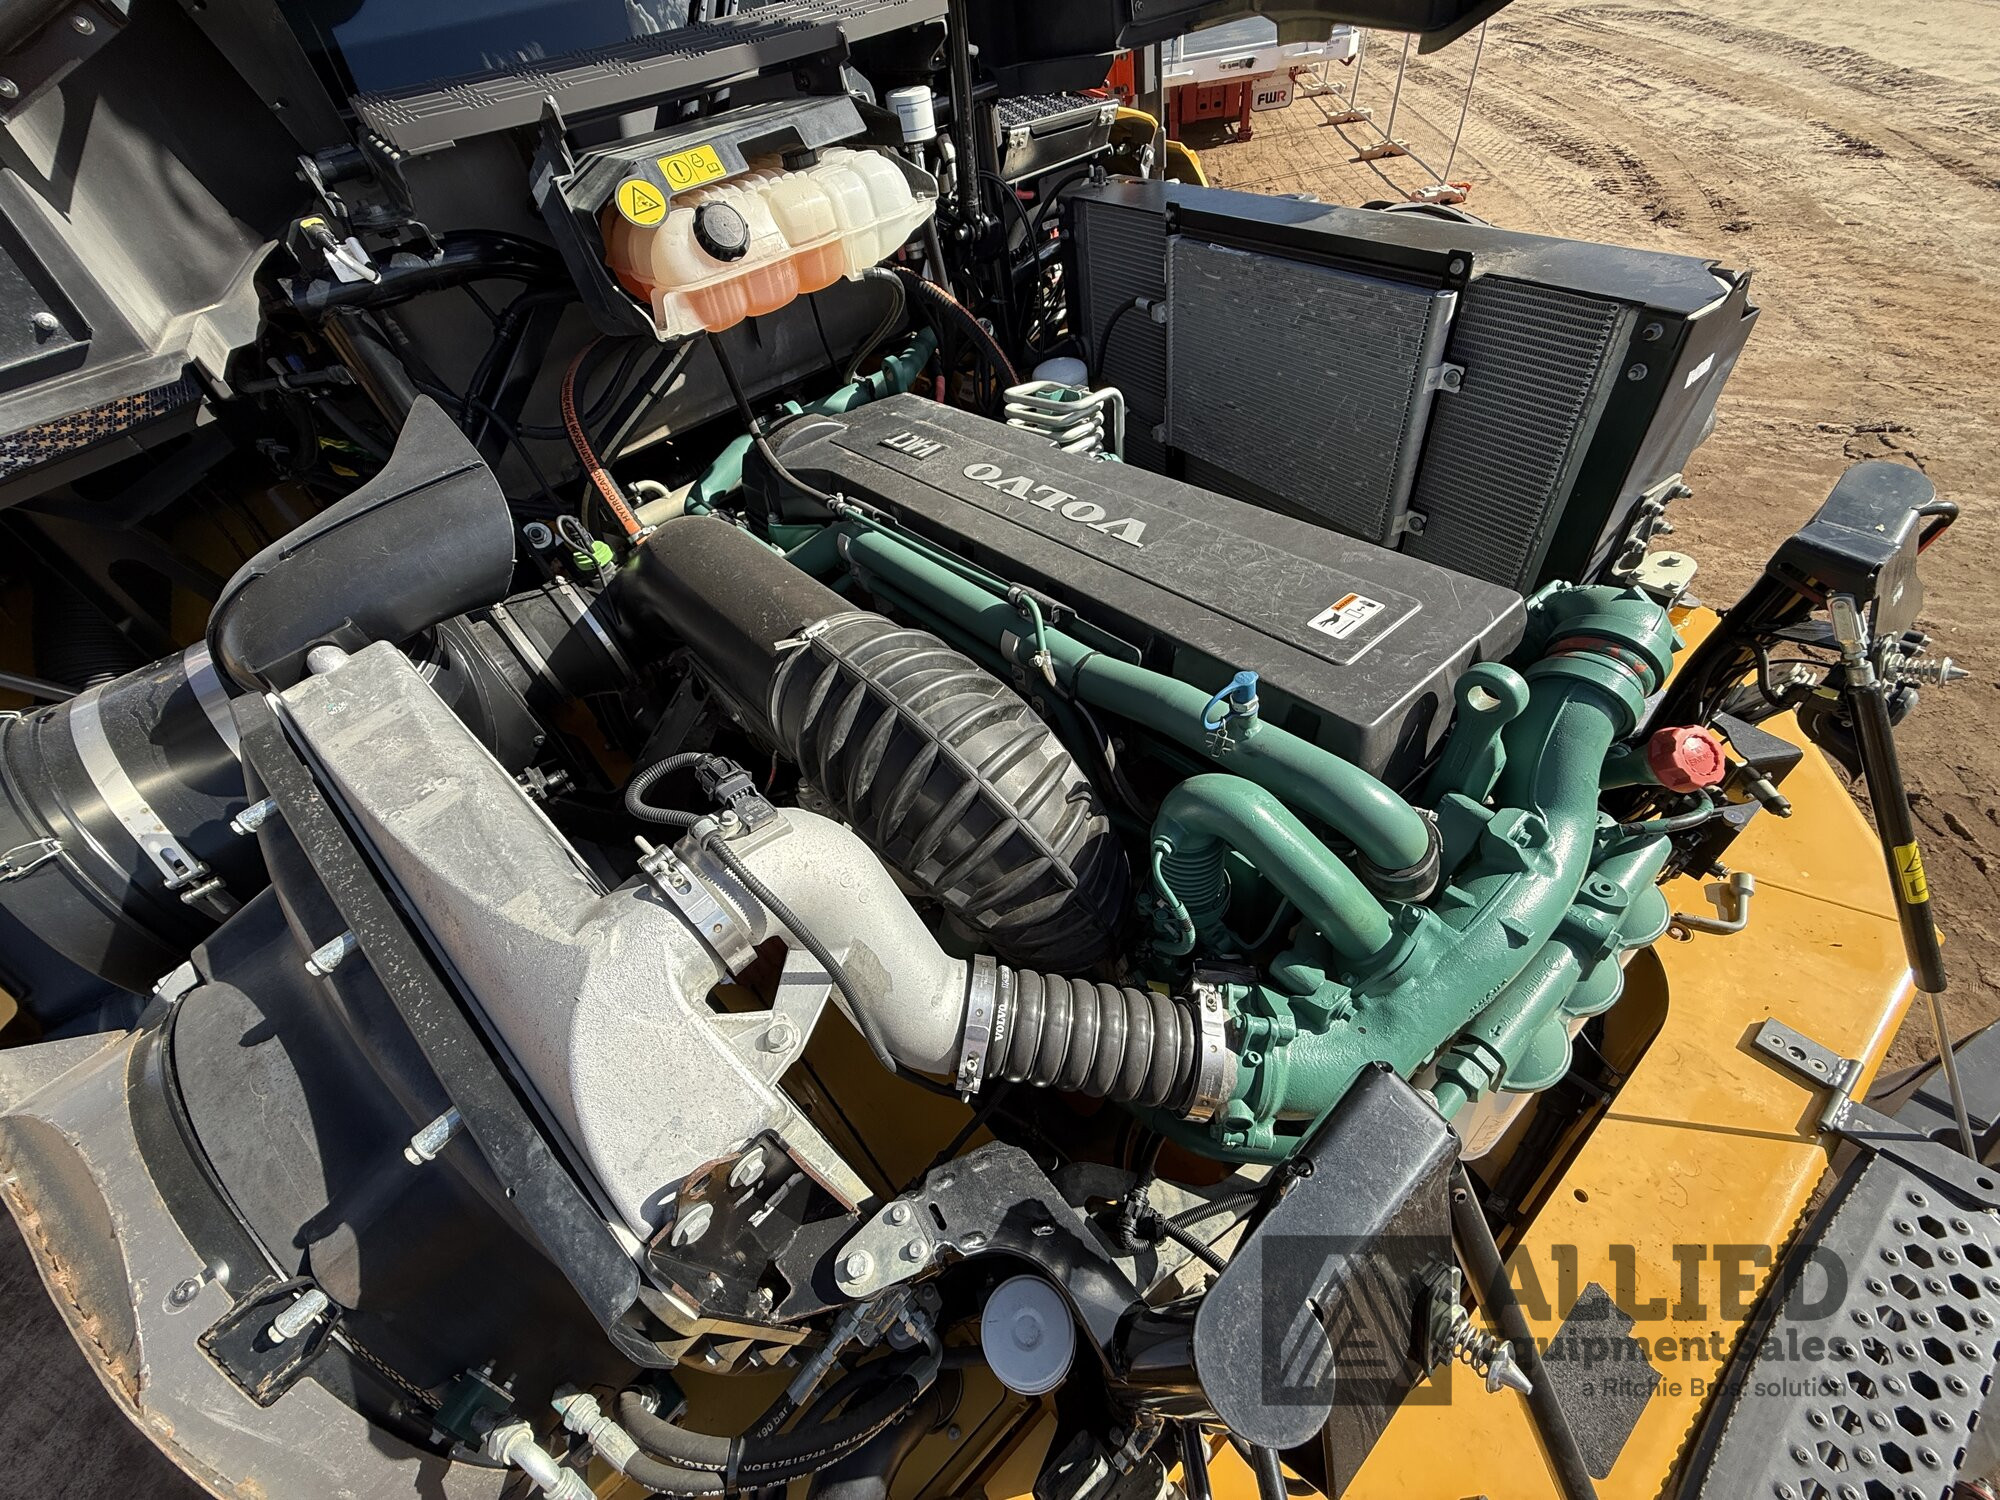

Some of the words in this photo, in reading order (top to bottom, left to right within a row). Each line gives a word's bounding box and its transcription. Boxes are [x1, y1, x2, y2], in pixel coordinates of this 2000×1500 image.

[1257, 90, 1287, 105] FWR
[593, 469, 631, 522] HYDROSCAND
[963, 463, 1147, 548] VOLVO
[994, 1002, 1009, 1042] VOLVO
[756, 1422, 774, 1439] 190
[773, 1406, 788, 1425] bar
